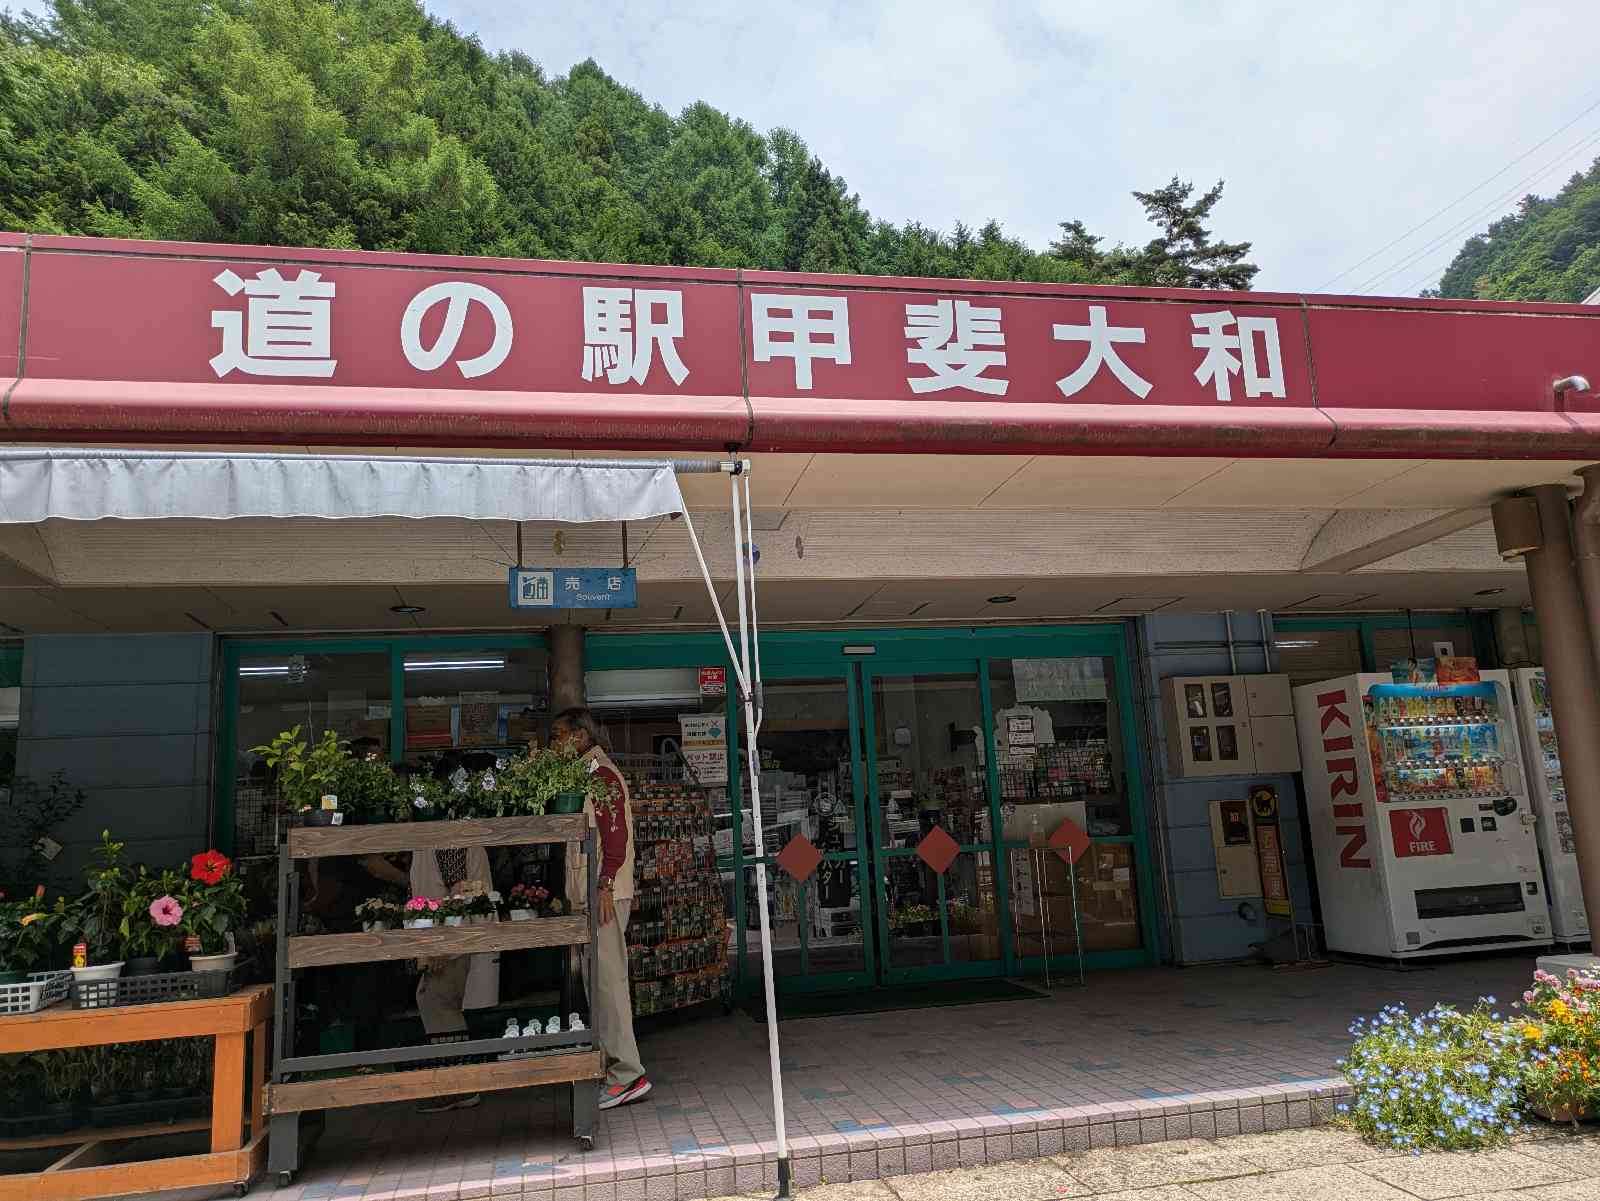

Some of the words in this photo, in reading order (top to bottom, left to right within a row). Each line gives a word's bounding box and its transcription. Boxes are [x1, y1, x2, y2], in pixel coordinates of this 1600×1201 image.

[209, 268, 1288, 402] 道の駅甲斐大和
[564, 577, 621, 591] 売店
[1317, 690, 1371, 868] KIRIN
[1409, 840, 1438, 854] FIRE
